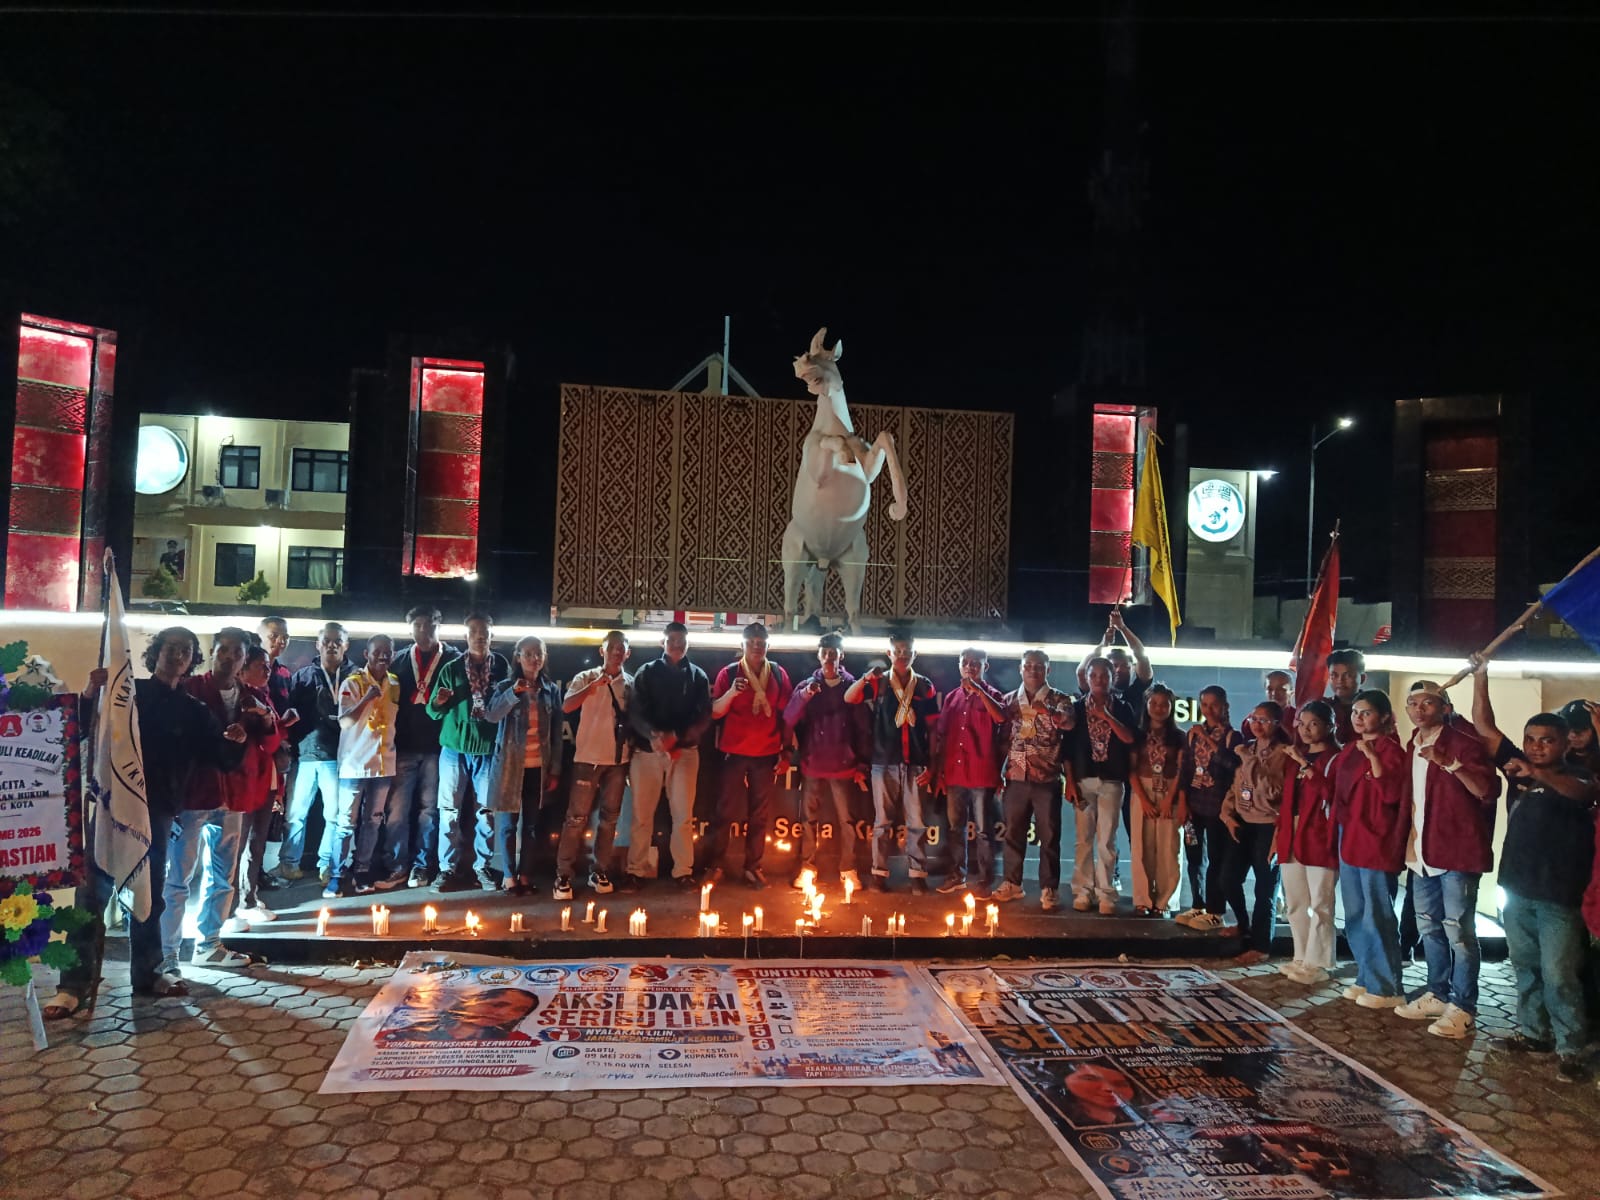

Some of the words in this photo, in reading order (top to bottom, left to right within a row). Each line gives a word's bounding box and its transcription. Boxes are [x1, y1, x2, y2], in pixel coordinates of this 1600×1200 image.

[15, 746, 60, 764] KEADILAN
[0, 779, 26, 791] CITA
[17, 790, 50, 801] HUKUM
[10, 800, 34, 810] KOTA
[17, 826, 42, 839] 2026
[774, 817, 834, 839] Sea
[751, 969, 830, 978] TUNTUTAN
[832, 969, 874, 977] KAMI
[547, 992, 625, 1010] AKSI
[638, 992, 736, 1010] DAMAI
[978, 999, 1098, 1025] AKSI
[537, 1010, 655, 1028] SERIBU
[665, 1010, 741, 1028] LILIN
[585, 1028, 643, 1036] NYALAKAN
[647, 1029, 676, 1037] LILIN,
[424, 1040, 477, 1048] FRANSISKA
[369, 1069, 405, 1079] TANPA
[407, 1067, 469, 1077] KEPASTIAN
[469, 1066, 517, 1076] HUKUM!
[1214, 1162, 1260, 1175] KOTA
